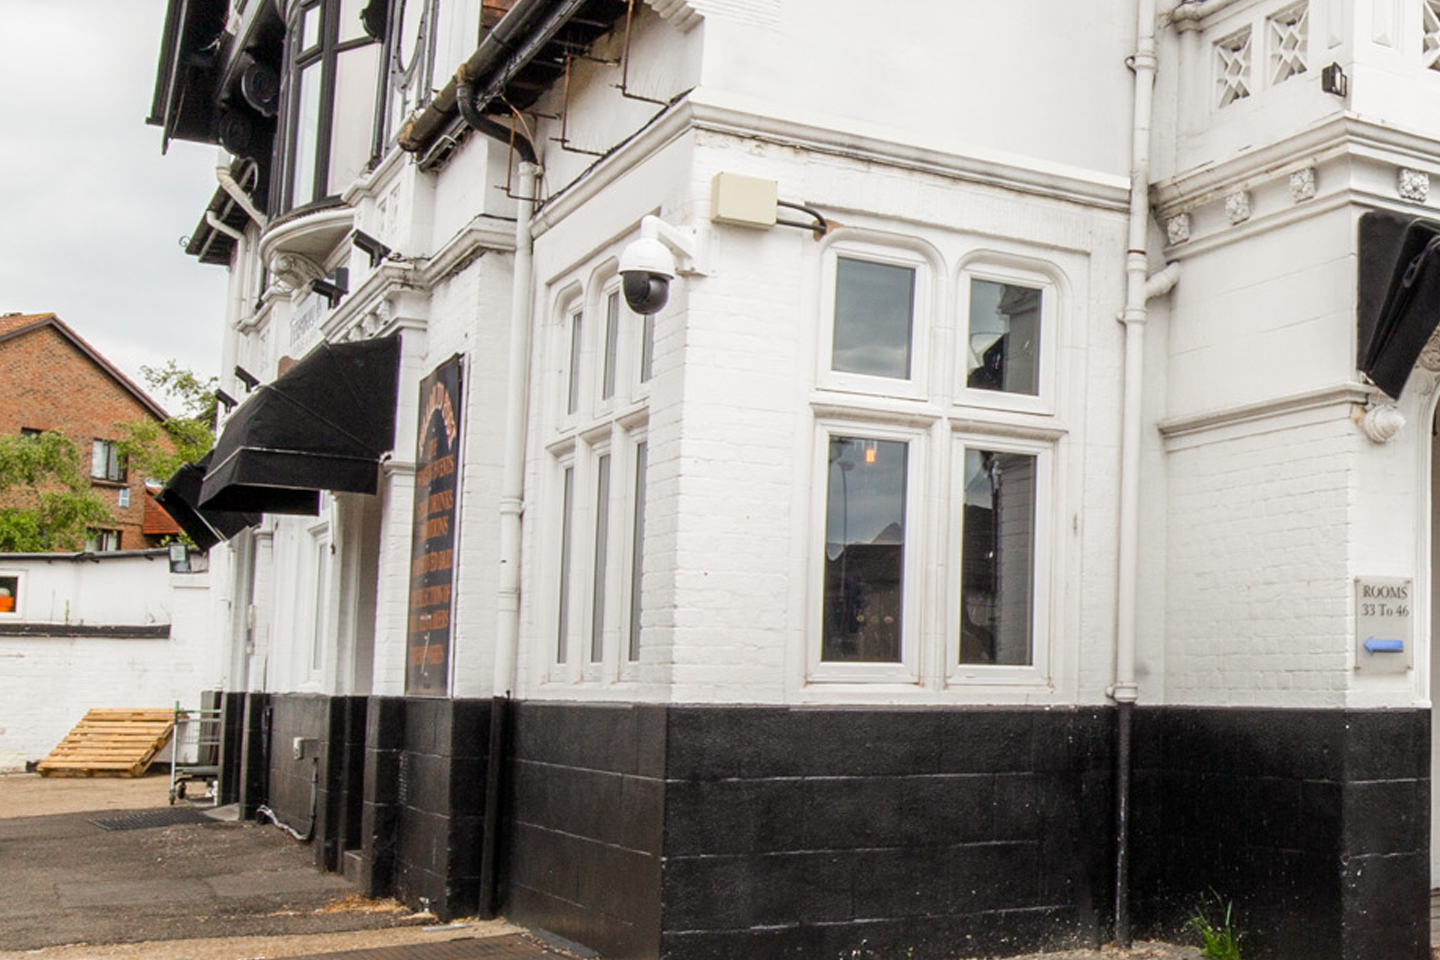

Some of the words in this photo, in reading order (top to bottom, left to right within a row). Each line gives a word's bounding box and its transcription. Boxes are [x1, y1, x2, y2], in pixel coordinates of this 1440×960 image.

[1362, 585, 1408, 599] ROOMS
[1362, 603, 1376, 616] 33
[1379, 603, 1393, 617] To
[1395, 604, 1410, 617] 46
